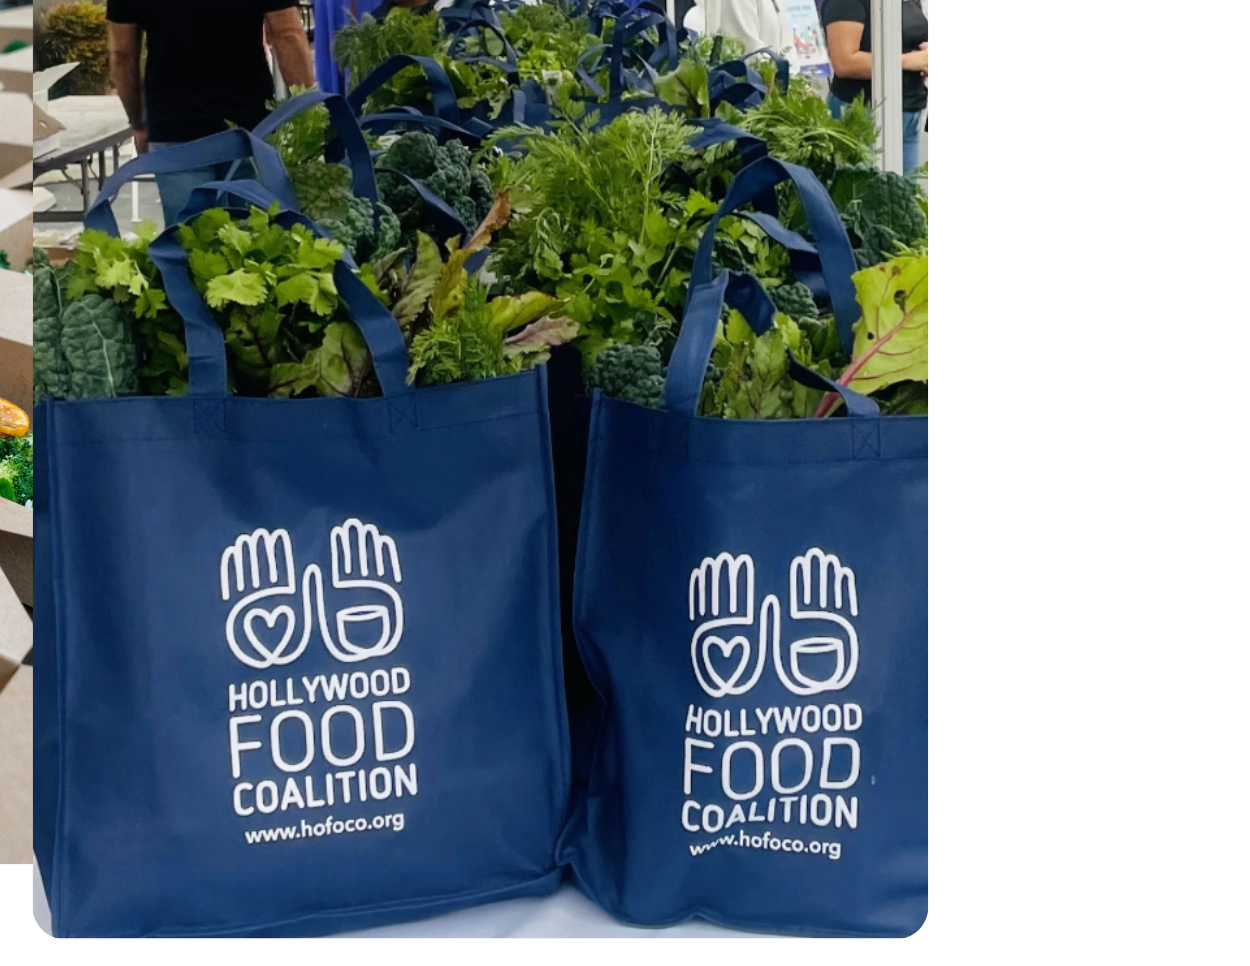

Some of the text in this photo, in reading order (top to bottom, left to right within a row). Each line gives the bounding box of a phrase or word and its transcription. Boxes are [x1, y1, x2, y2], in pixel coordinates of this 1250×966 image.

[229, 667, 410, 712] HOLLYWOOD
[229, 700, 415, 779] FOOD
[685, 703, 863, 737] HOLLYWOOD
[233, 762, 418, 816] COALITION
[683, 737, 861, 800] FOOD
[245, 813, 405, 844] www.hofoco.org
[682, 793, 858, 833] COALITION
